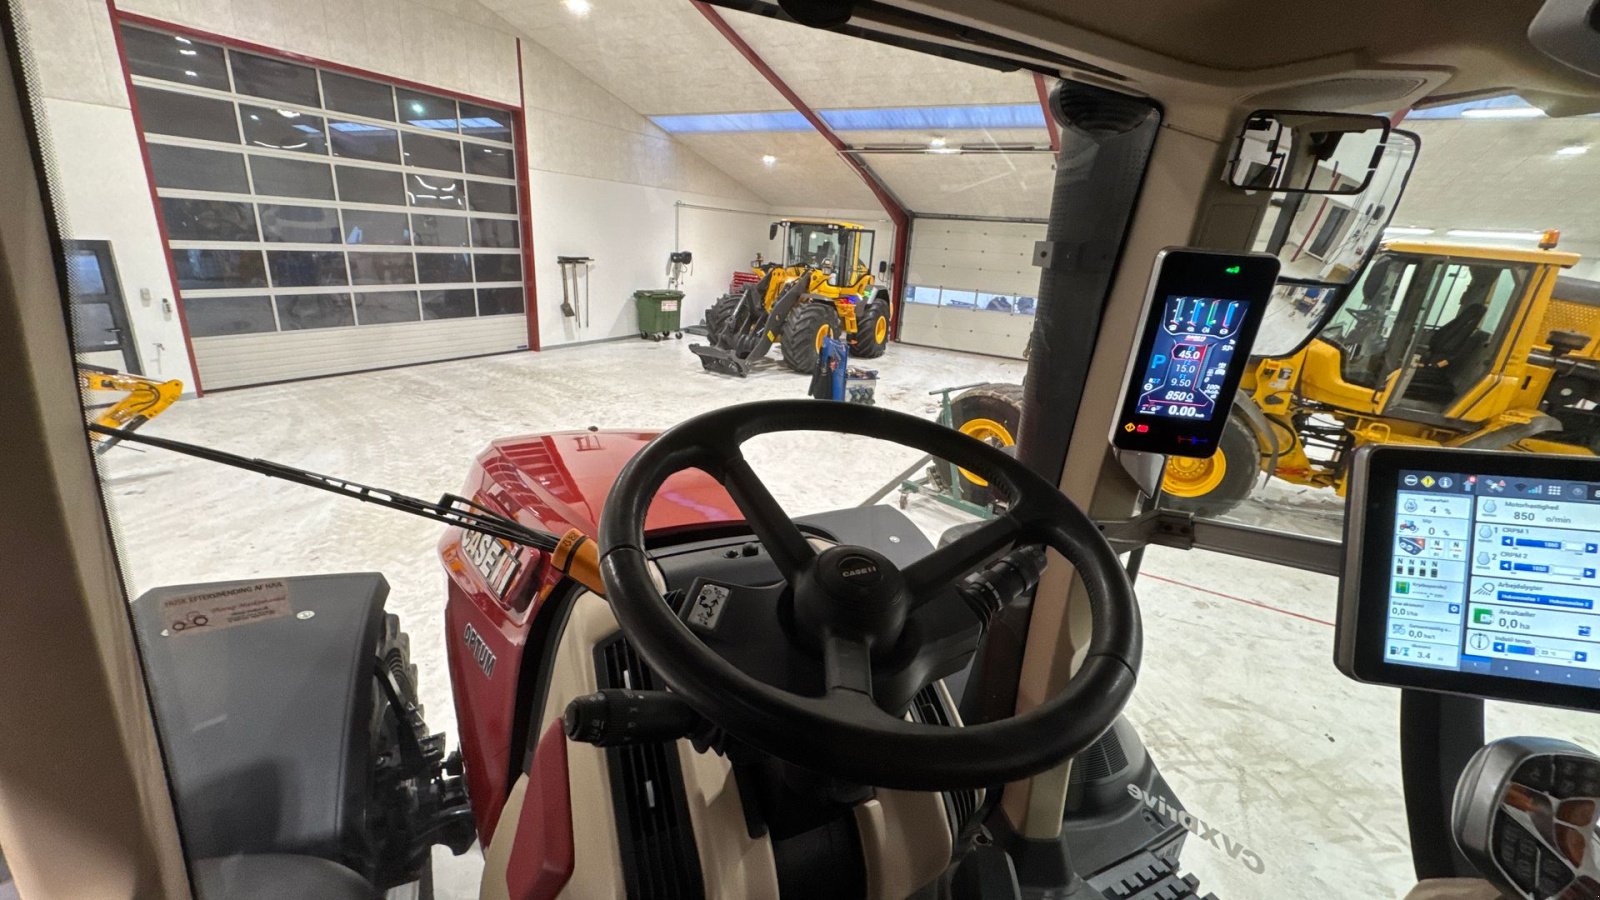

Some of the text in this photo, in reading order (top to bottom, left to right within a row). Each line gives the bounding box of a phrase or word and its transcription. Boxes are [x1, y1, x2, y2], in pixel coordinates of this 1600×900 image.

[1178, 350, 1201, 360] 45.0
[1151, 354, 1166, 368] P
[1176, 364, 1196, 374] 15.0
[1171, 378, 1192, 387] 9.50
[1165, 390, 1187, 401] 850
[1168, 404, 1196, 416] 0.00
[1430, 506, 1437, 514] 4
[1514, 512, 1536, 521] 850
[1428, 527, 1436, 536] 0
[1392, 608, 1406, 616] 0,0
[1499, 618, 1518, 629] 0,0
[1408, 630, 1423, 638] 0,0
[464, 623, 496, 679] OPTUM
